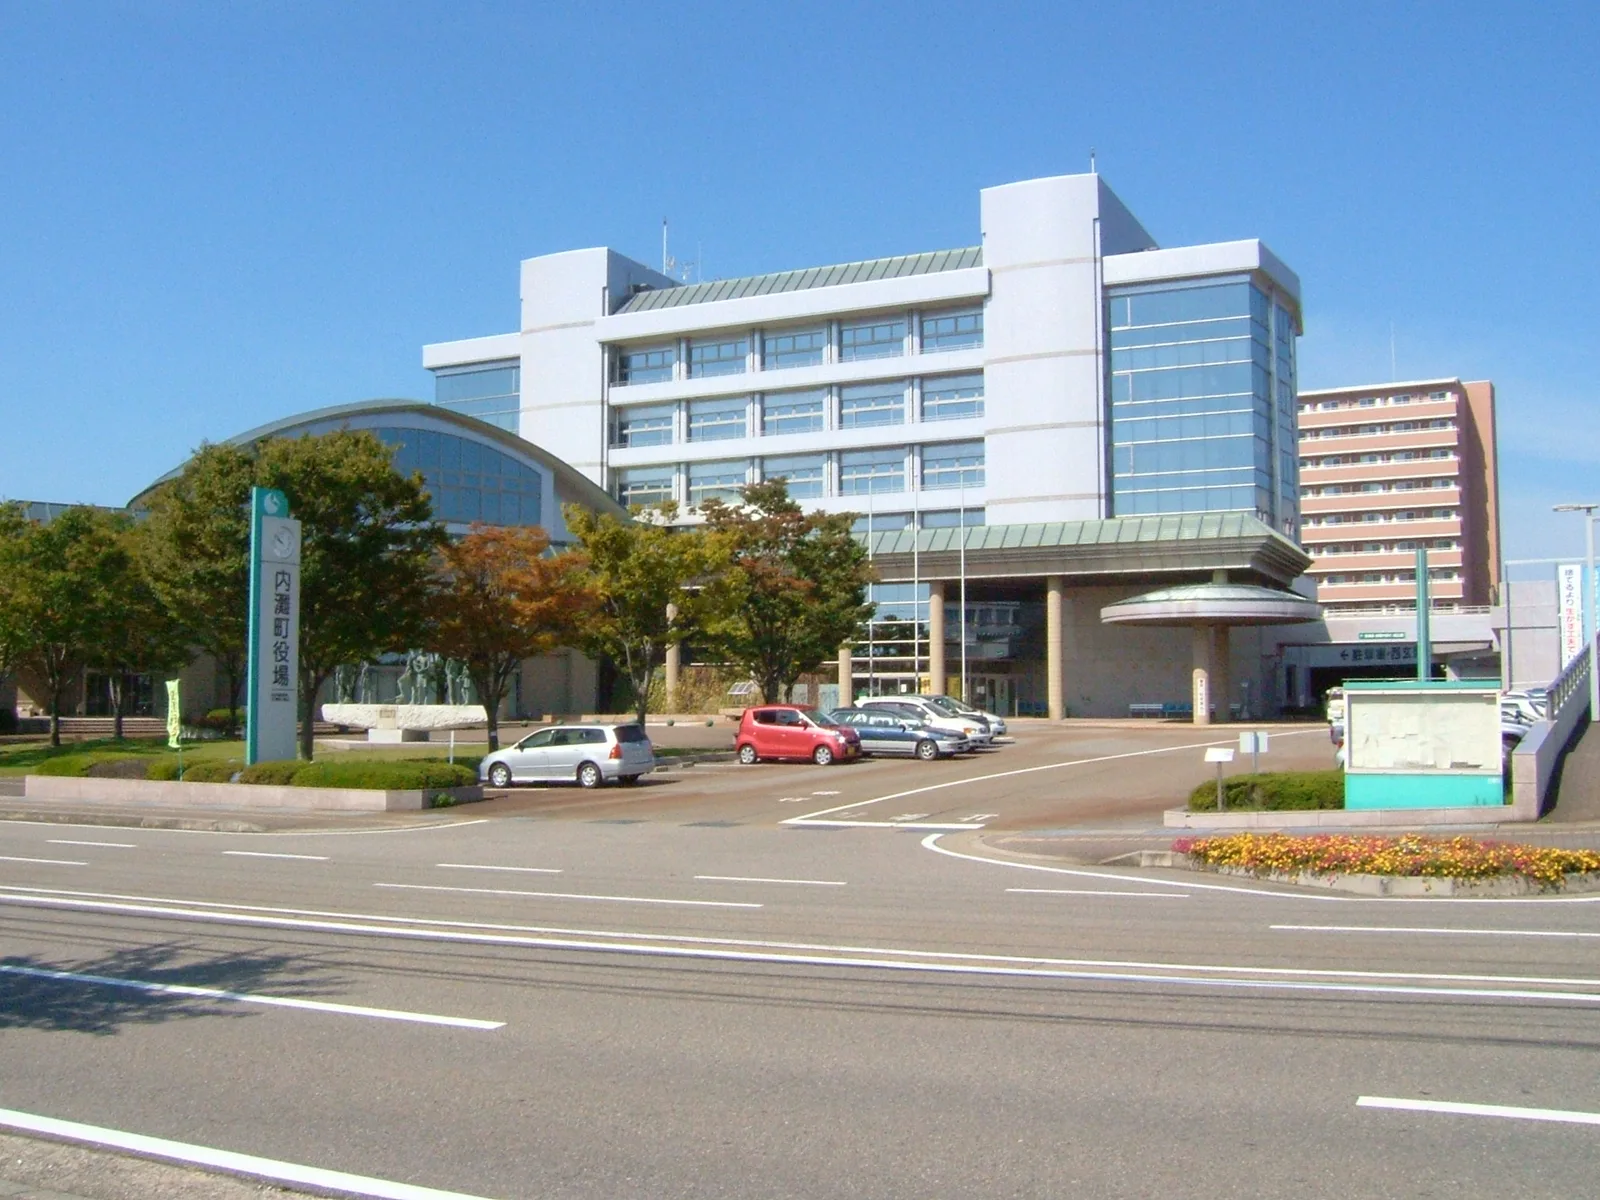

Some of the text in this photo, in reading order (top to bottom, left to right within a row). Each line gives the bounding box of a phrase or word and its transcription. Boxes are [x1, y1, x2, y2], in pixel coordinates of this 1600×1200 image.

[273, 571, 291, 685] 内灘町役場
